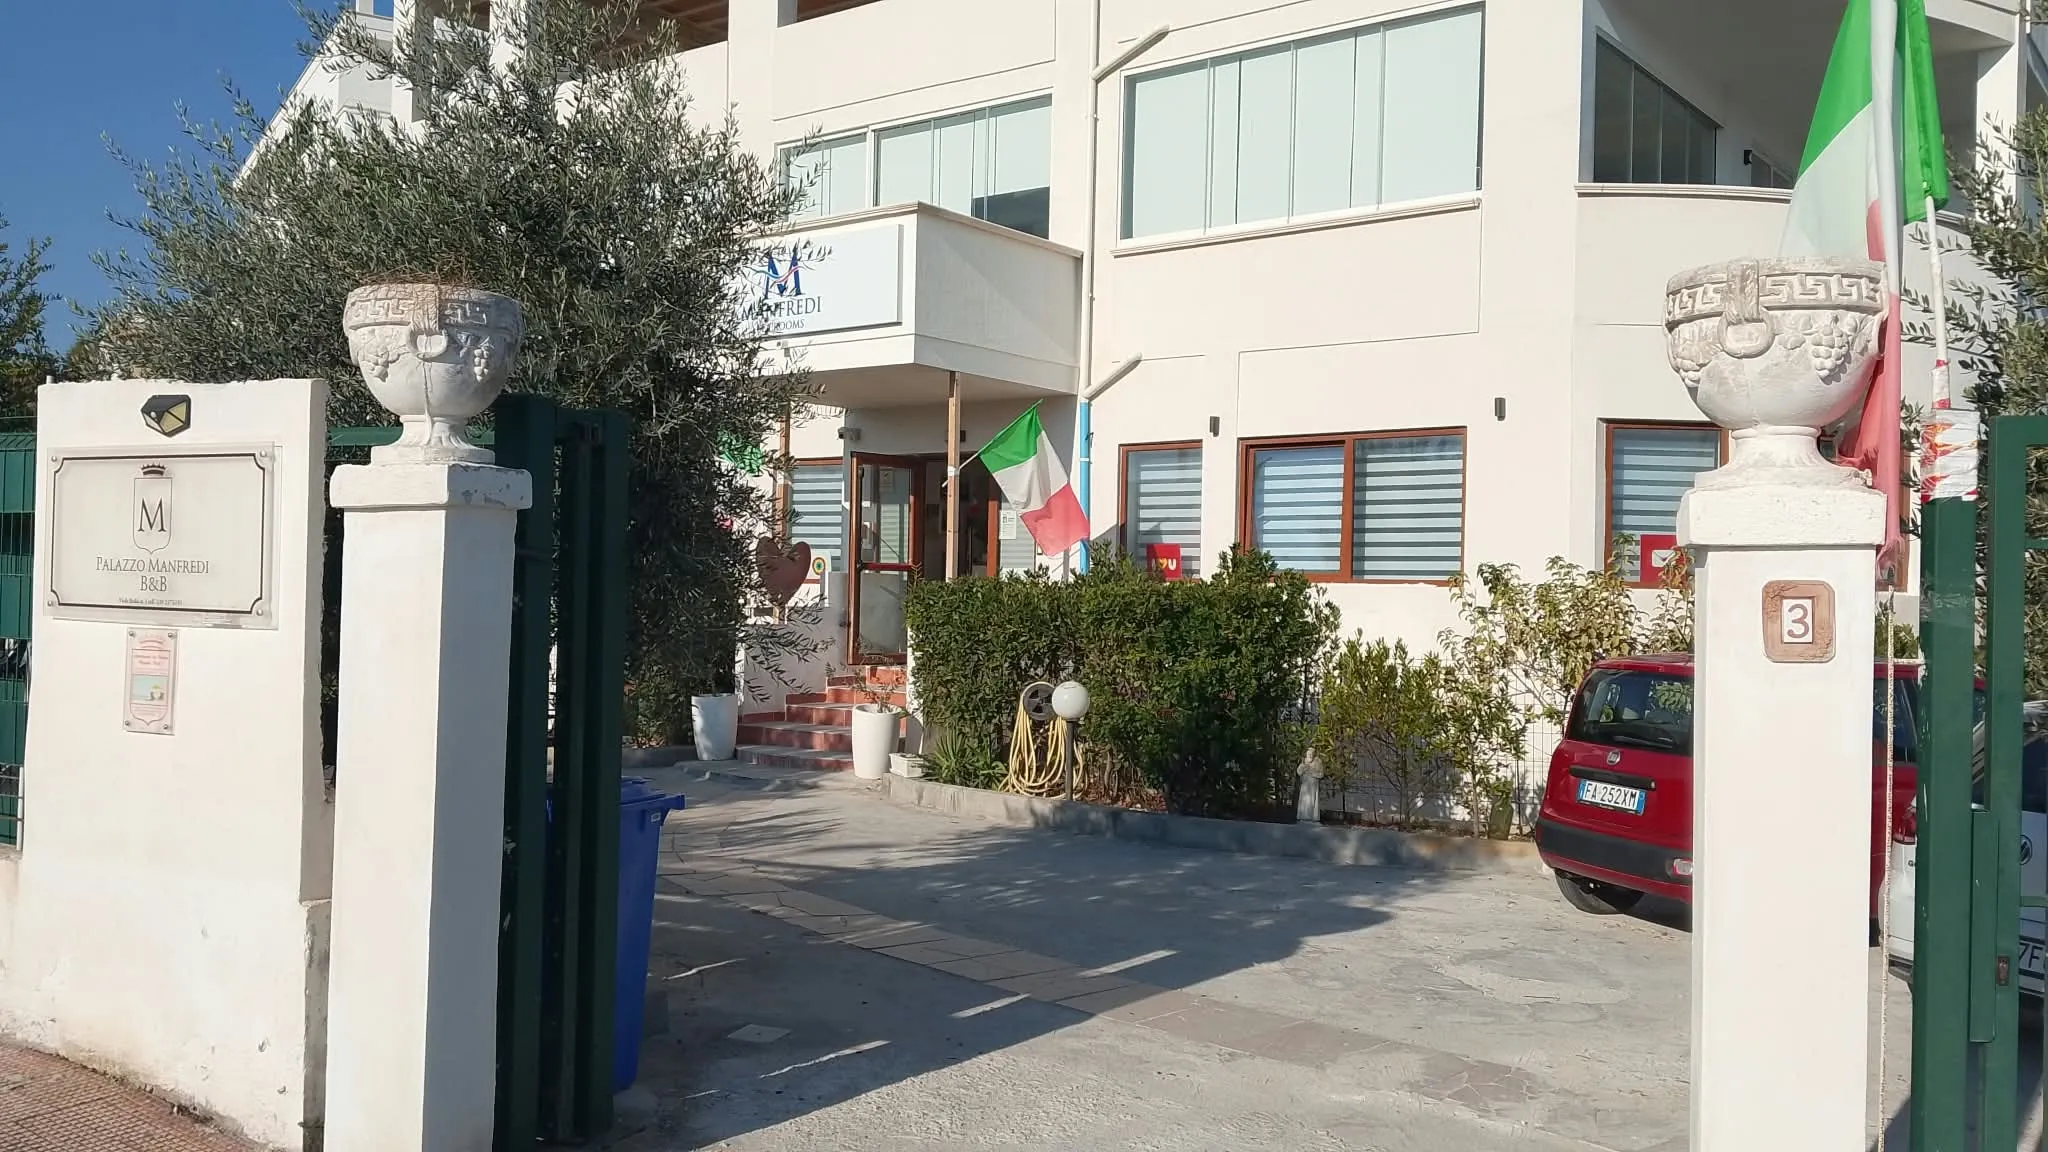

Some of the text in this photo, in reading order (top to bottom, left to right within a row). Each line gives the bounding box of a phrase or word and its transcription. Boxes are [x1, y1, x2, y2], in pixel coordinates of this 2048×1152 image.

[138, 498, 167, 532] M
[96, 557, 209, 574] PALAZZO MANFREDI
[1167, 558, 1177, 571] U
[140, 575, 167, 592] B&B
[1787, 603, 1810, 639] 3
[1584, 782, 1638, 809] FA 252XM
